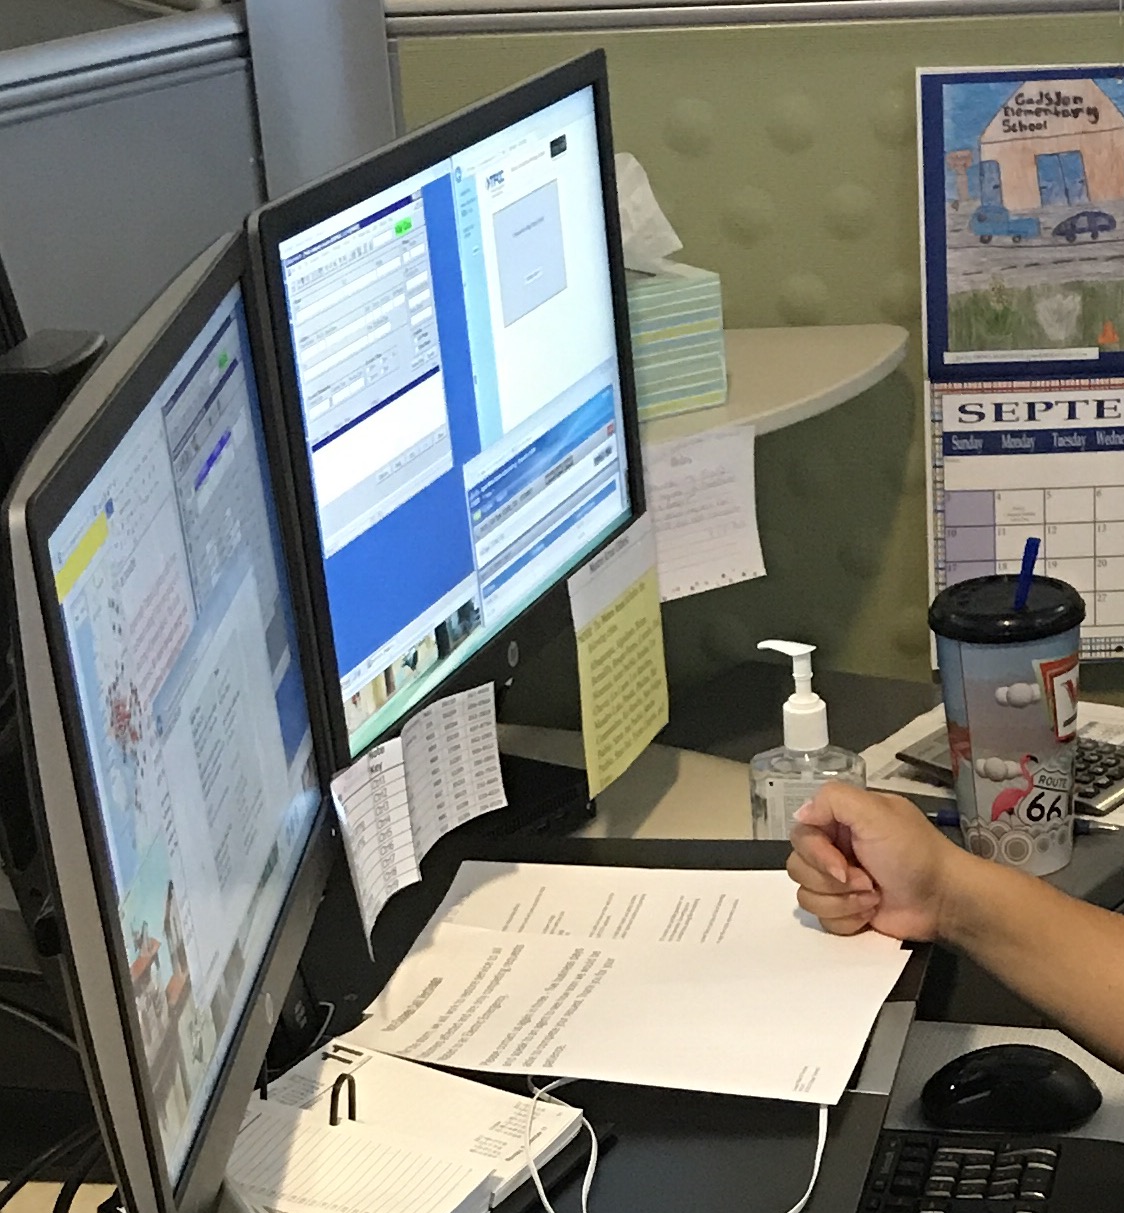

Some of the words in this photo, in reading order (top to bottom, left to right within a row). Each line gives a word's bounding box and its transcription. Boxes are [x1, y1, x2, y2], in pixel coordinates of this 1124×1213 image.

[1002, 119, 1047, 133] School
[951, 435, 983, 454] Sunday
[1001, 434, 1035, 452] Monday
[1052, 432, 1086, 450] Tuesday
[998, 528, 1006, 536] 11
[1048, 526, 1057, 534] 12
[948, 564, 957, 572] 17
[1048, 561, 1057, 569] 19
[1097, 560, 1107, 568] 20
[1097, 593, 1107, 602] 27
[1038, 775, 1067, 788] ROUTE
[1027, 791, 1061, 821] 66
